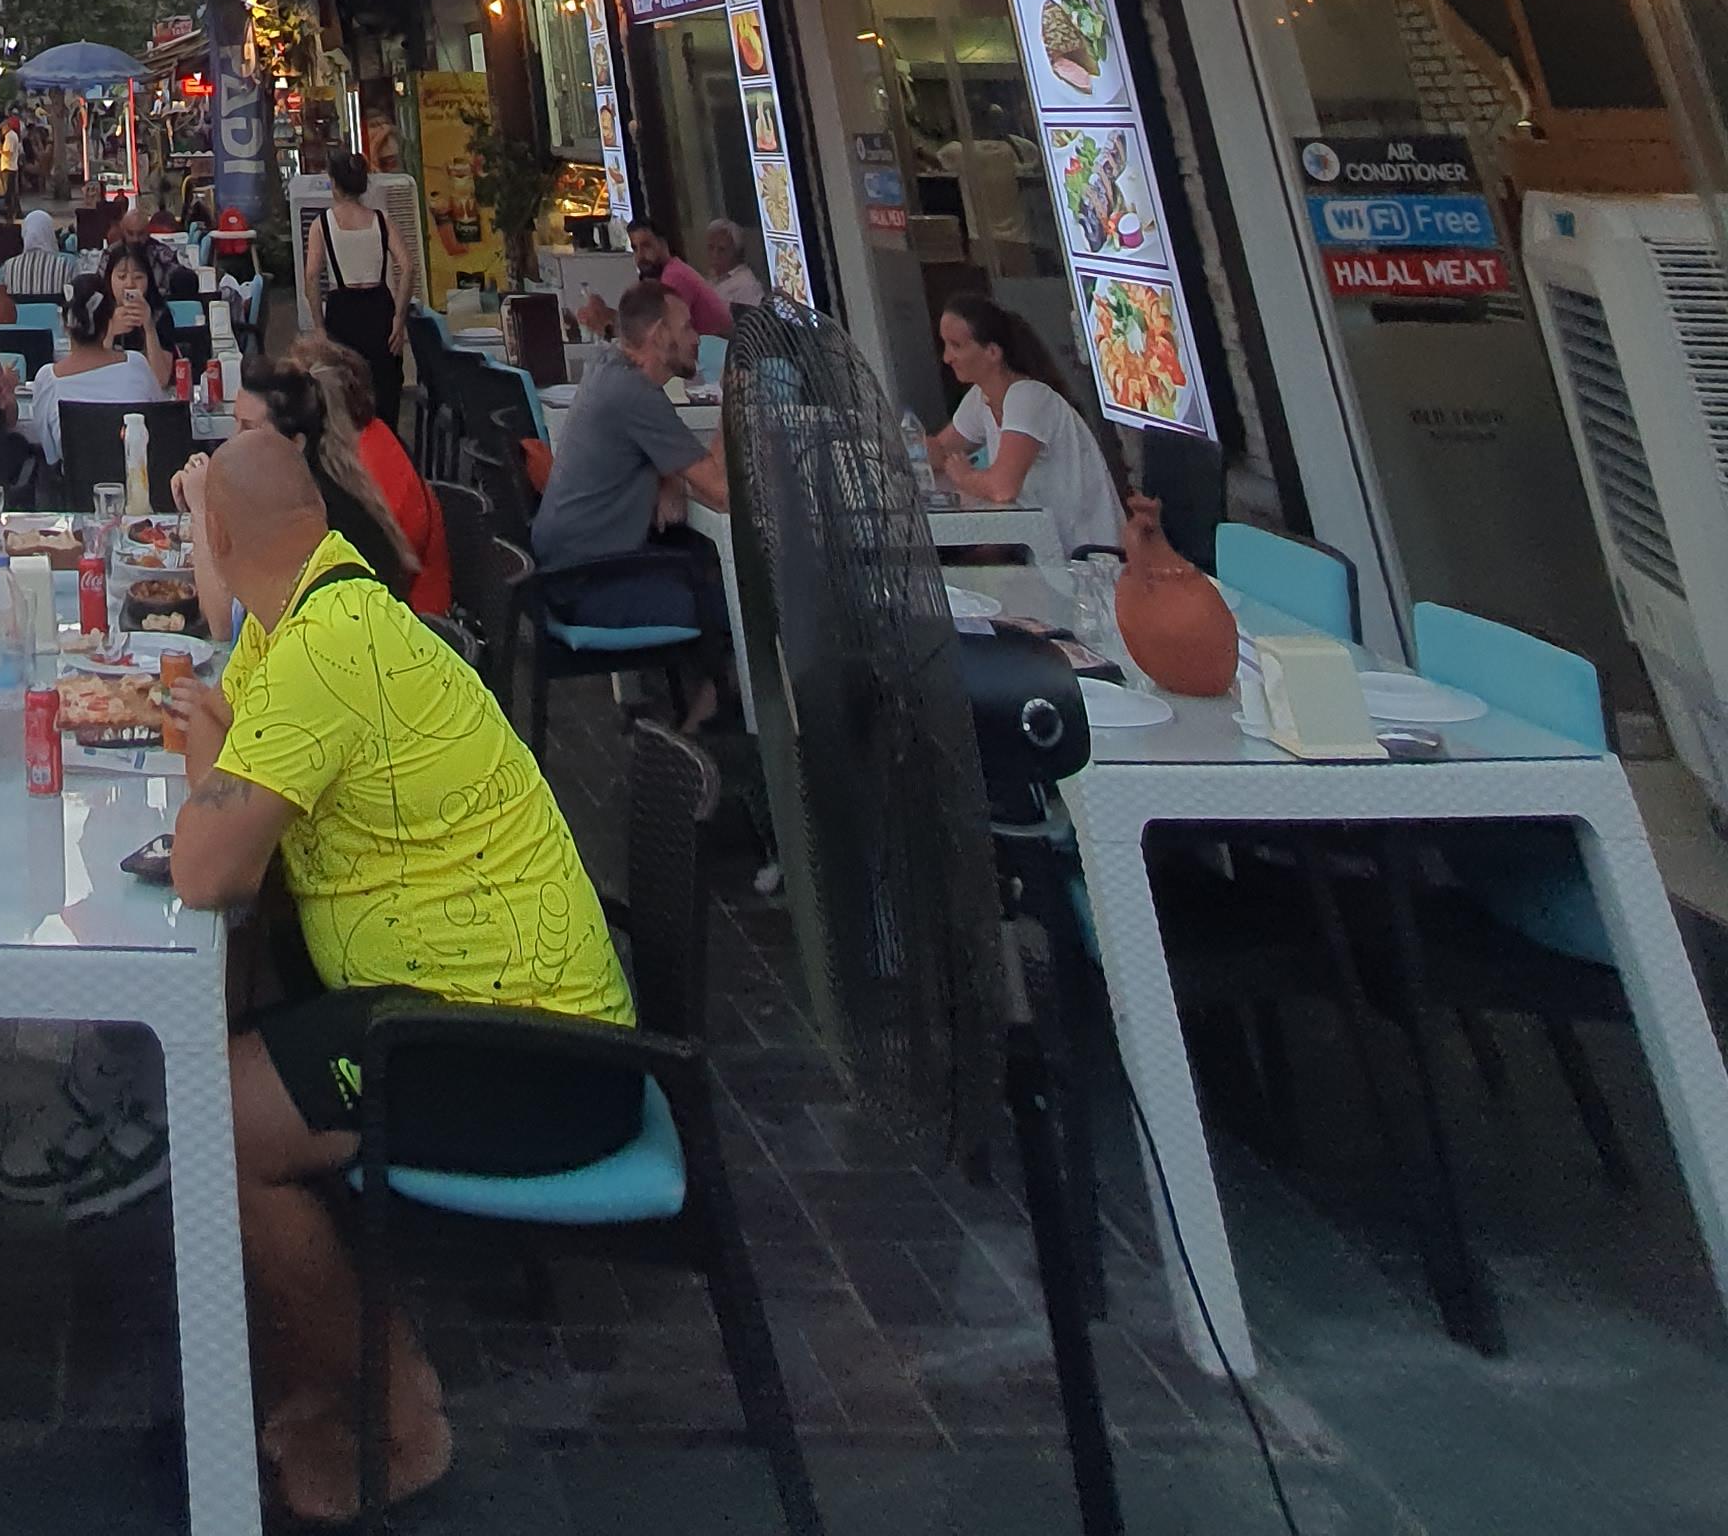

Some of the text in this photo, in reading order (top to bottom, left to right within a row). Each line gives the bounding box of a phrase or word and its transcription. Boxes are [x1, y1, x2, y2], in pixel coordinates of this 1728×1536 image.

[1387, 143, 1416, 161] AIR
[1346, 163, 1469, 182] CONDITIONER
[1413, 205, 1481, 234] Free
[1332, 259, 1497, 287] HALAL MEAT
